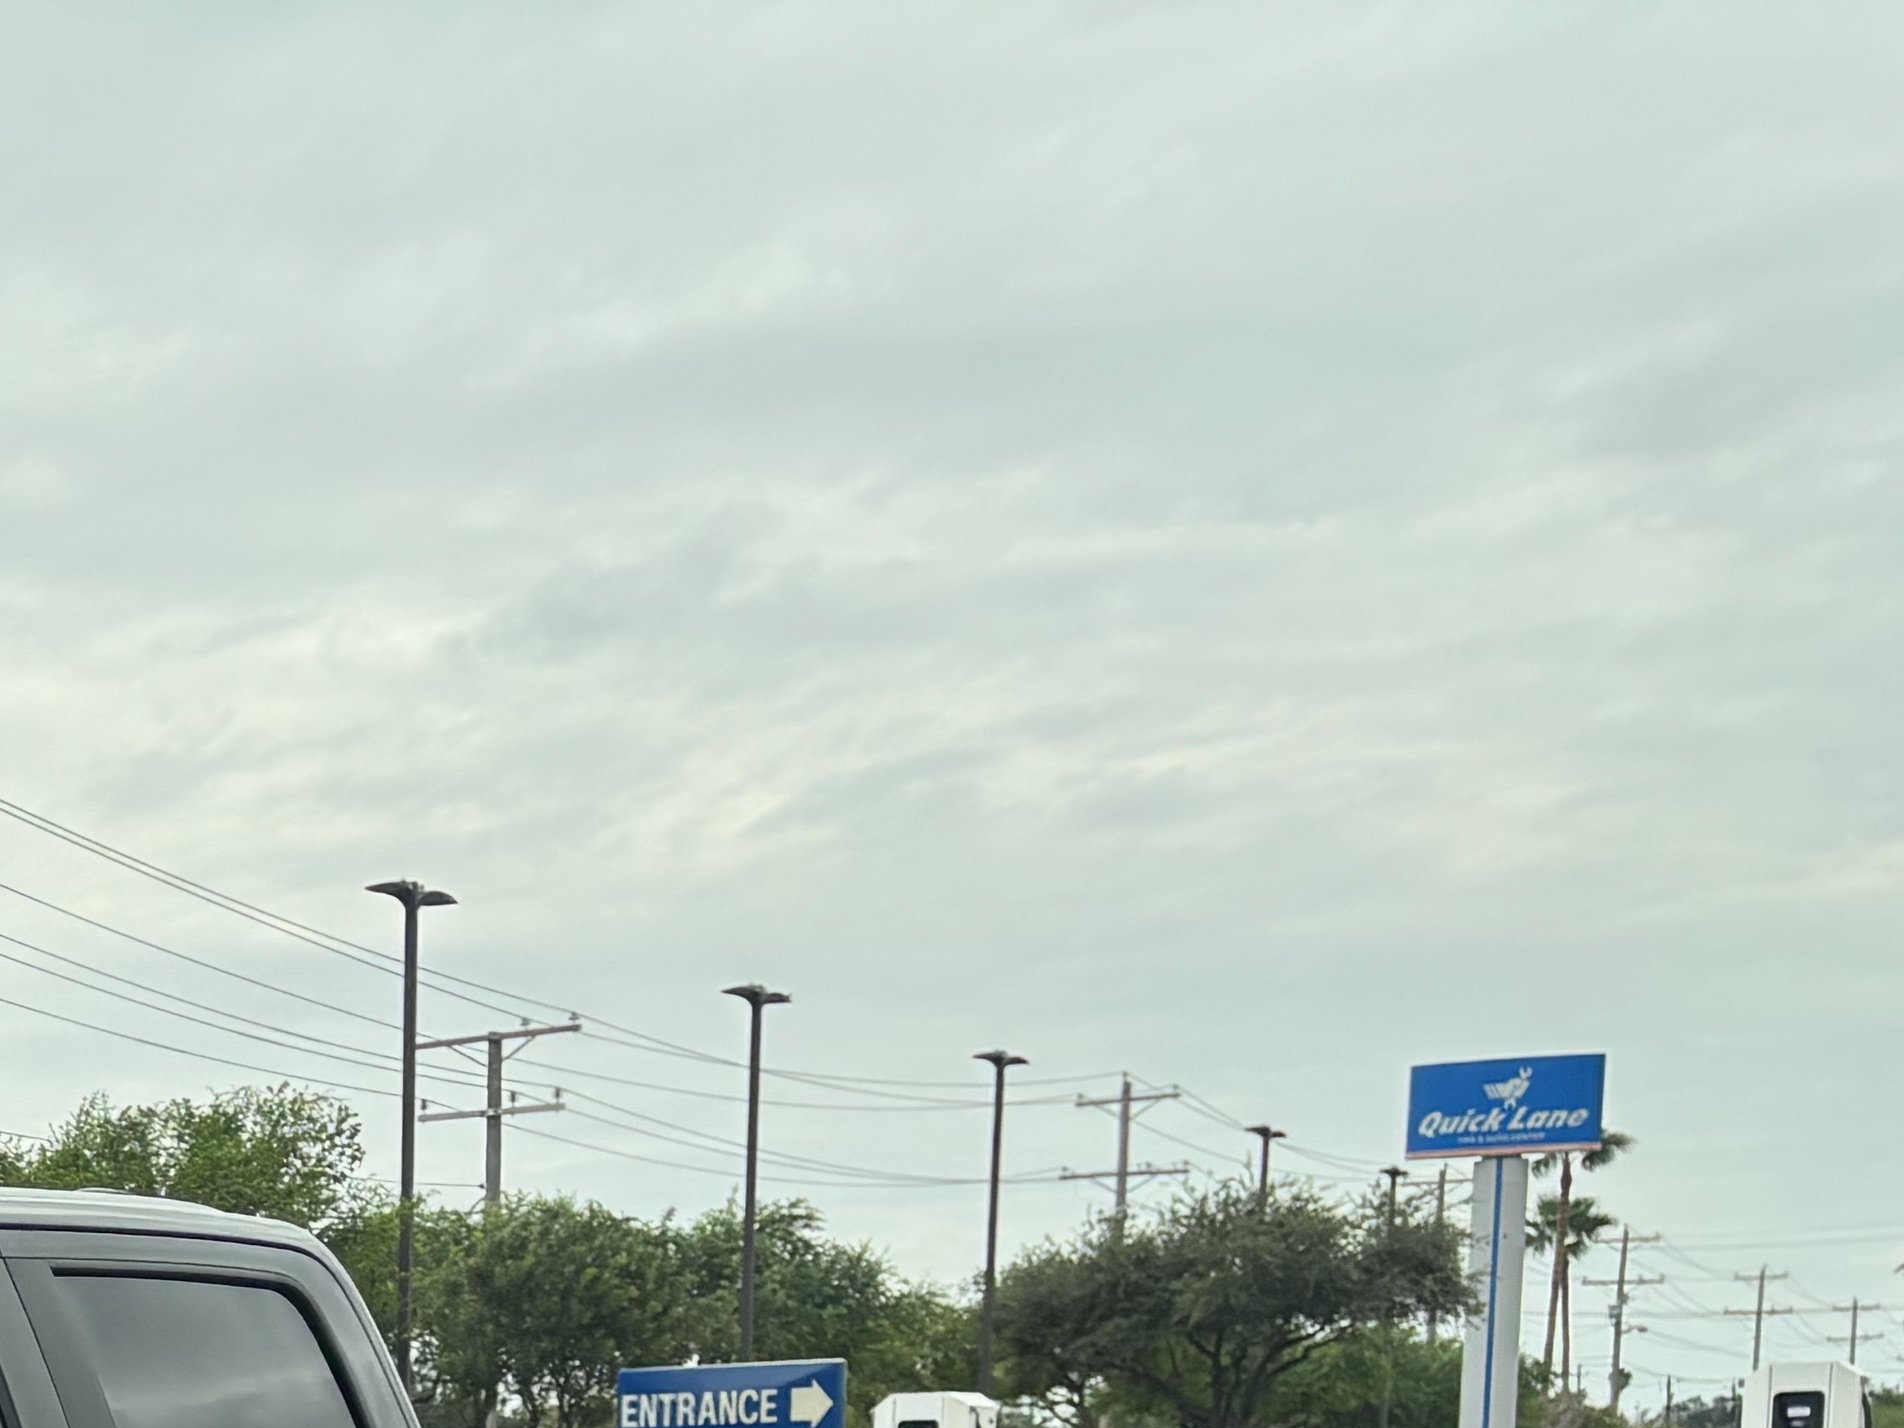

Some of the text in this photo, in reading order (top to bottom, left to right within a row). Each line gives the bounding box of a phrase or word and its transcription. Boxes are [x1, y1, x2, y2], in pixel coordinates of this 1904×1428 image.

[1418, 1105, 1590, 1138] Quick Lane
[620, 1388, 779, 1428] ENTRANCE
